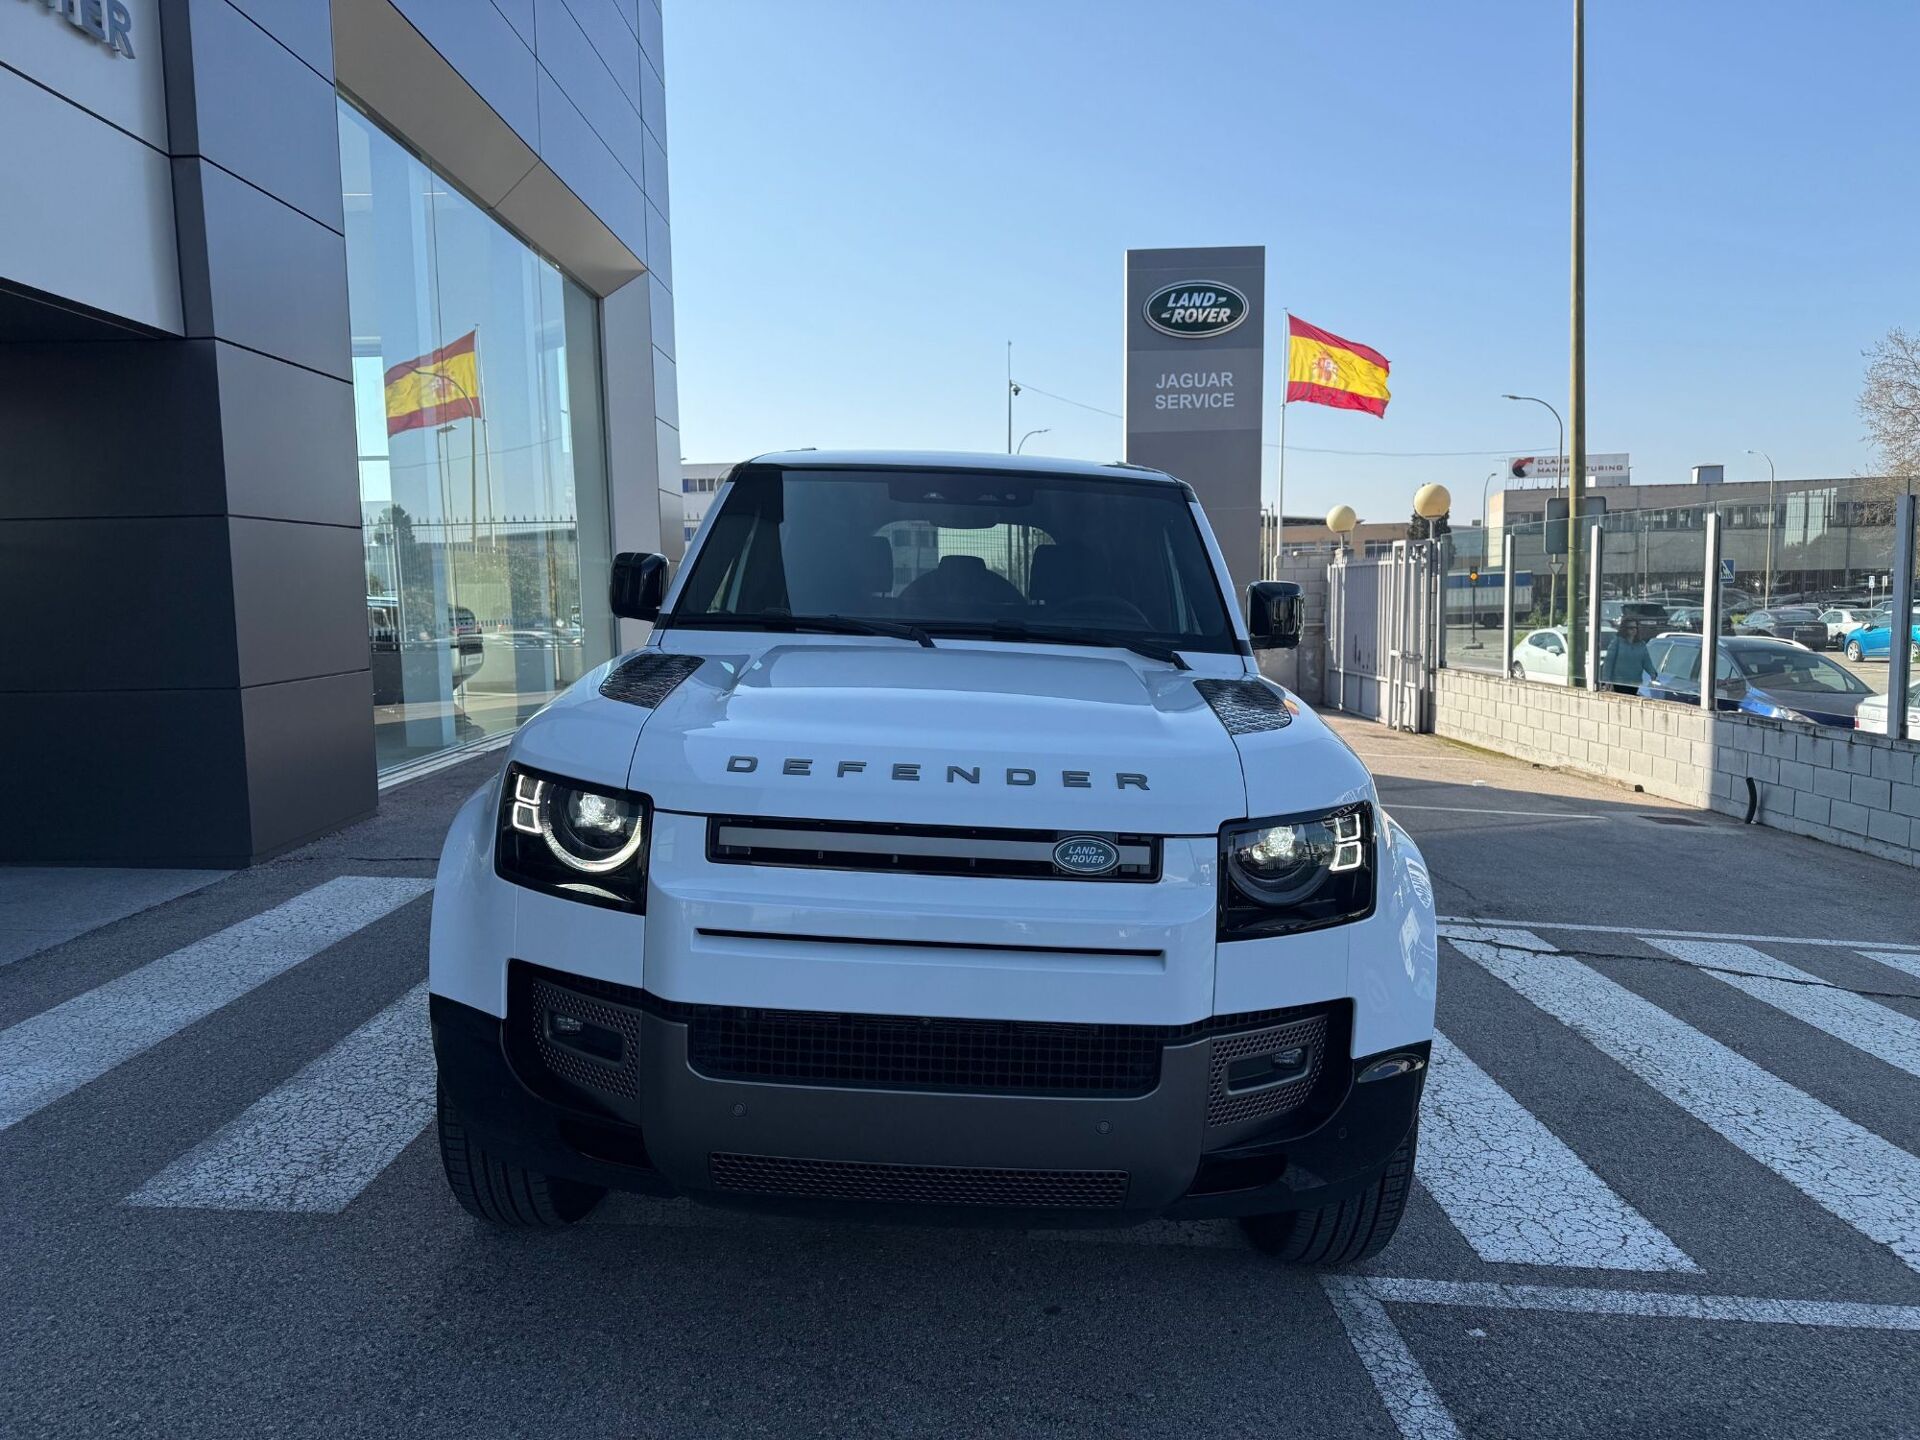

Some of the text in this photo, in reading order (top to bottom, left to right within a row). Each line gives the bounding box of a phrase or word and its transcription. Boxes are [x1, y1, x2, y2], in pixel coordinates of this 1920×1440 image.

[1167, 292, 1216, 308] LAND
[1171, 308, 1231, 323] ROVER
[1156, 372, 1233, 389] JAGUAR
[1155, 392, 1235, 410] SERVICE
[727, 755, 1150, 790] DEFENDER
[1068, 846, 1097, 855] LAND
[1070, 855, 1105, 864] ROVER
